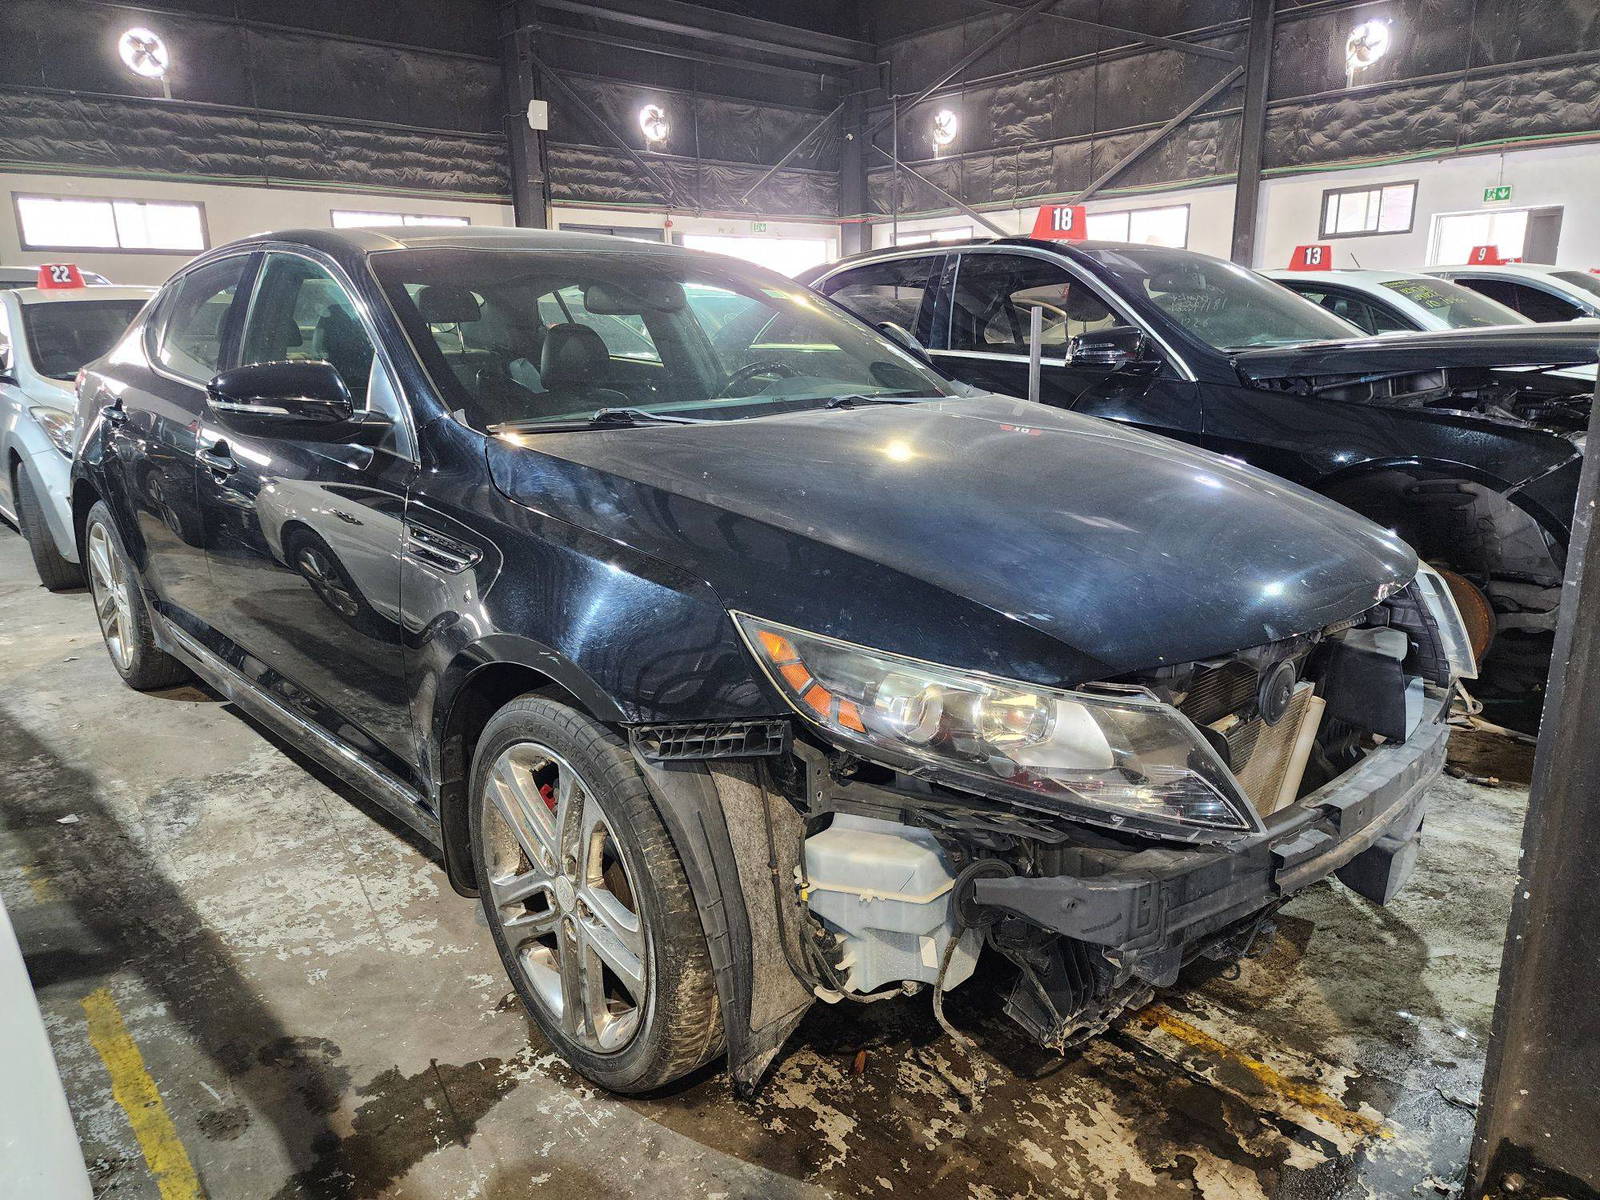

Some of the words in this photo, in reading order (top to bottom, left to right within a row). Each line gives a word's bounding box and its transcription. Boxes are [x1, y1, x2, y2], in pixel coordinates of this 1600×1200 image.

[1053, 207, 1073, 231] 18
[1305, 247, 1322, 264] 13
[1478, 247, 1487, 261] 9
[50, 265, 72, 283] 22
